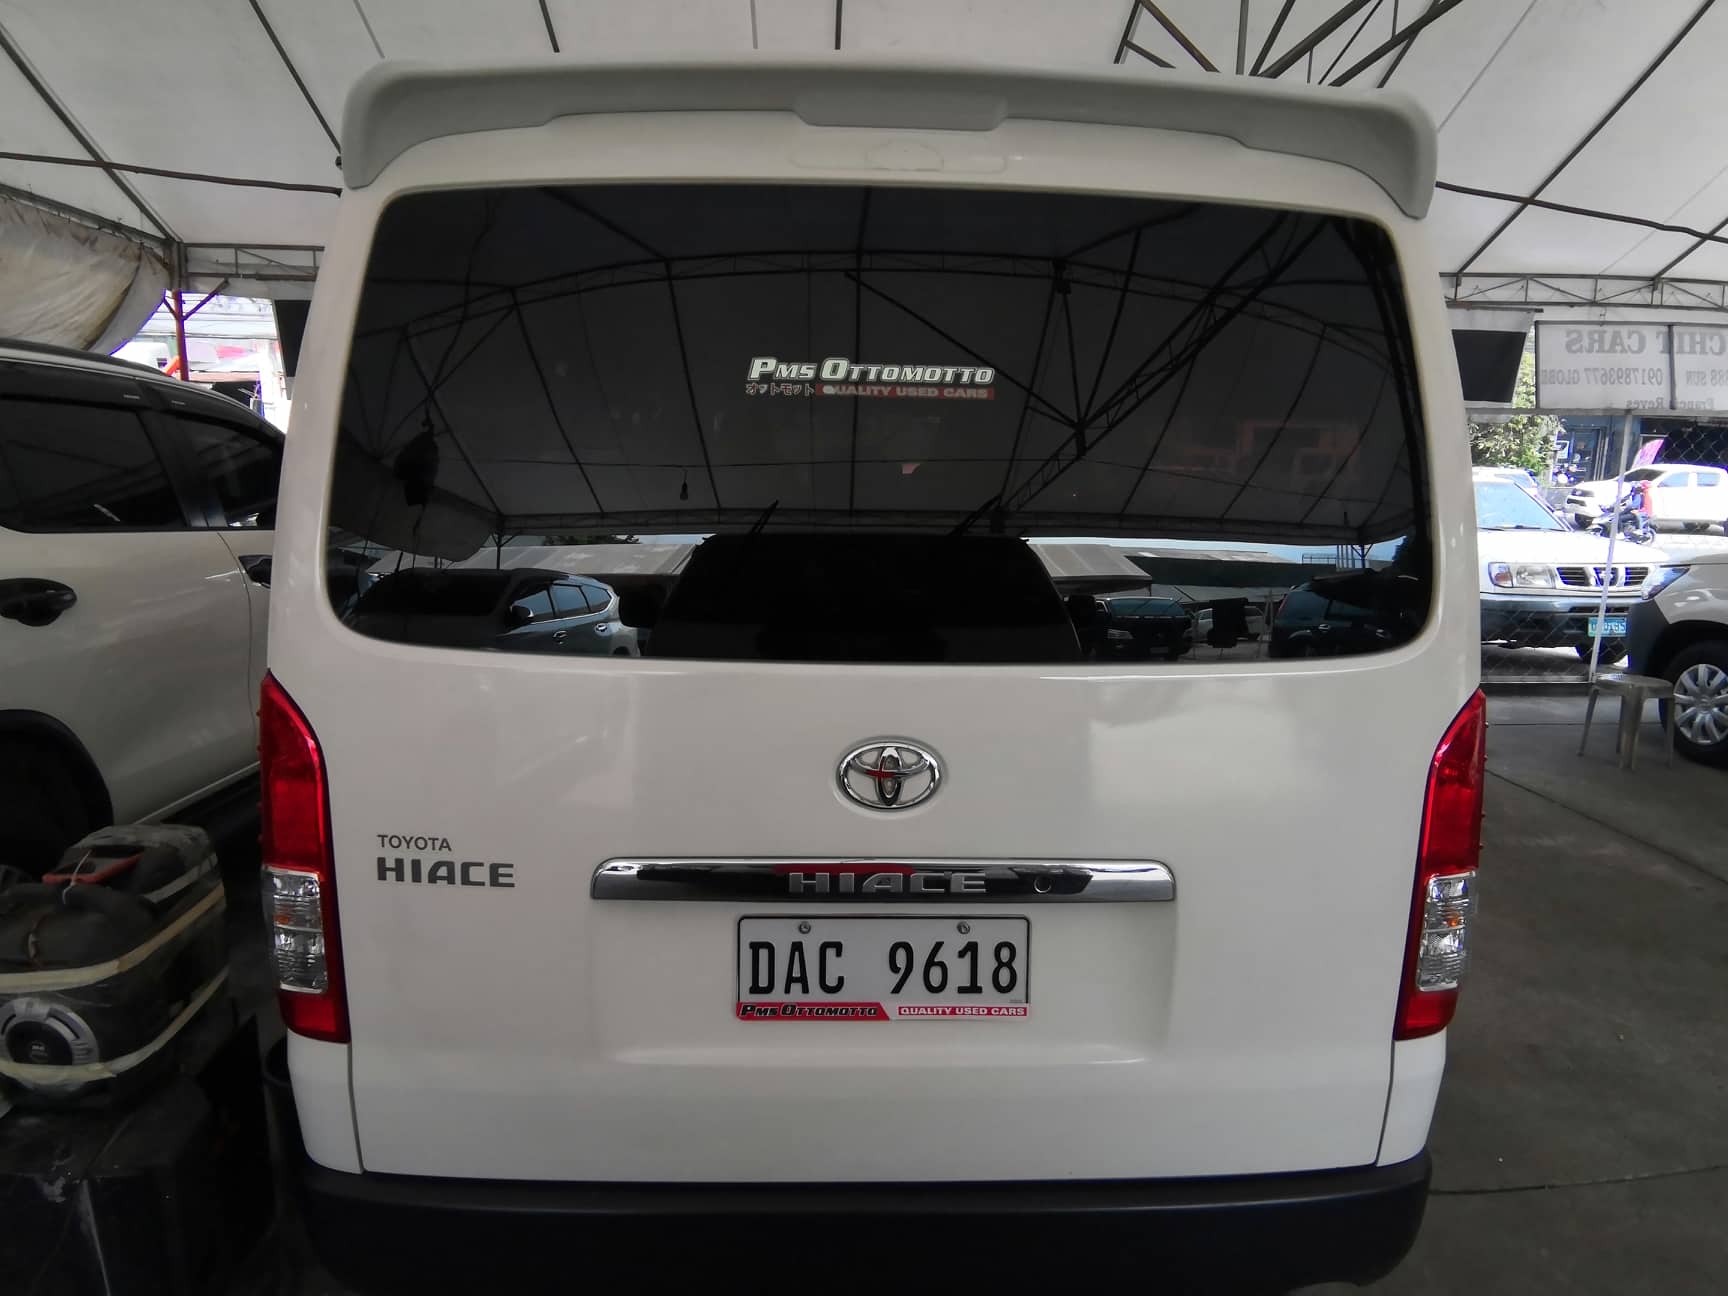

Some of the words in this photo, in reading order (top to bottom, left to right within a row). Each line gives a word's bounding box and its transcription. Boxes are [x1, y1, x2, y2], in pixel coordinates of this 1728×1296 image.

[821, 384, 893, 397] QUALITY
[895, 385, 939, 398] USED
[942, 386, 989, 399] CARS
[376, 834, 452, 852] TOYOTA
[376, 856, 516, 888] HIACE
[788, 871, 987, 893] HIACE
[748, 941, 845, 995] DAC
[888, 940, 1018, 995] 9618
[900, 1006, 952, 1017] QUALITY
[954, 1007, 988, 1017] USED
[990, 1007, 1025, 1017] CARS
